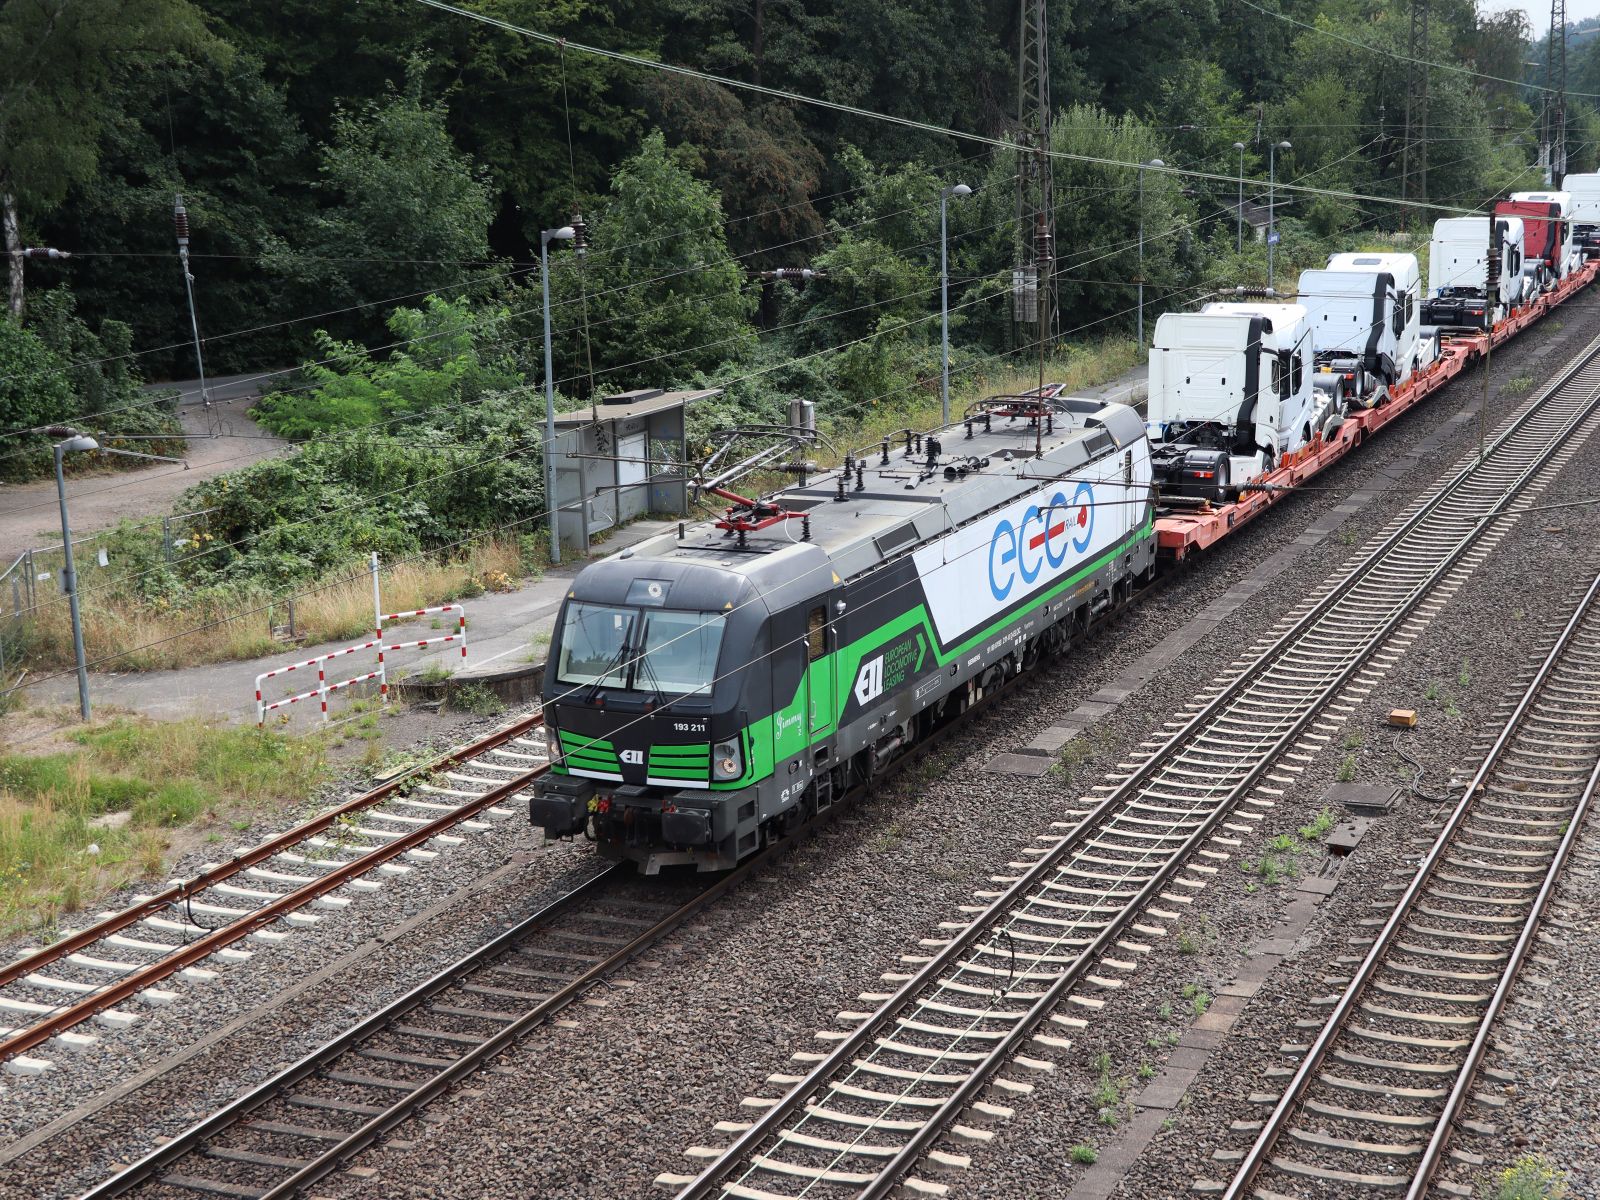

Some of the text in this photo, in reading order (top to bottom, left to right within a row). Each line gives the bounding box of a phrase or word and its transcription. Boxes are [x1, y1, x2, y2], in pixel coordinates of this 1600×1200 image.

[884, 640, 912, 664] EUROPEAN
[884, 648, 918, 679] LOCOMOTIVE
[882, 670, 905, 693] LEASING
[673, 723, 706, 732] 193 211
